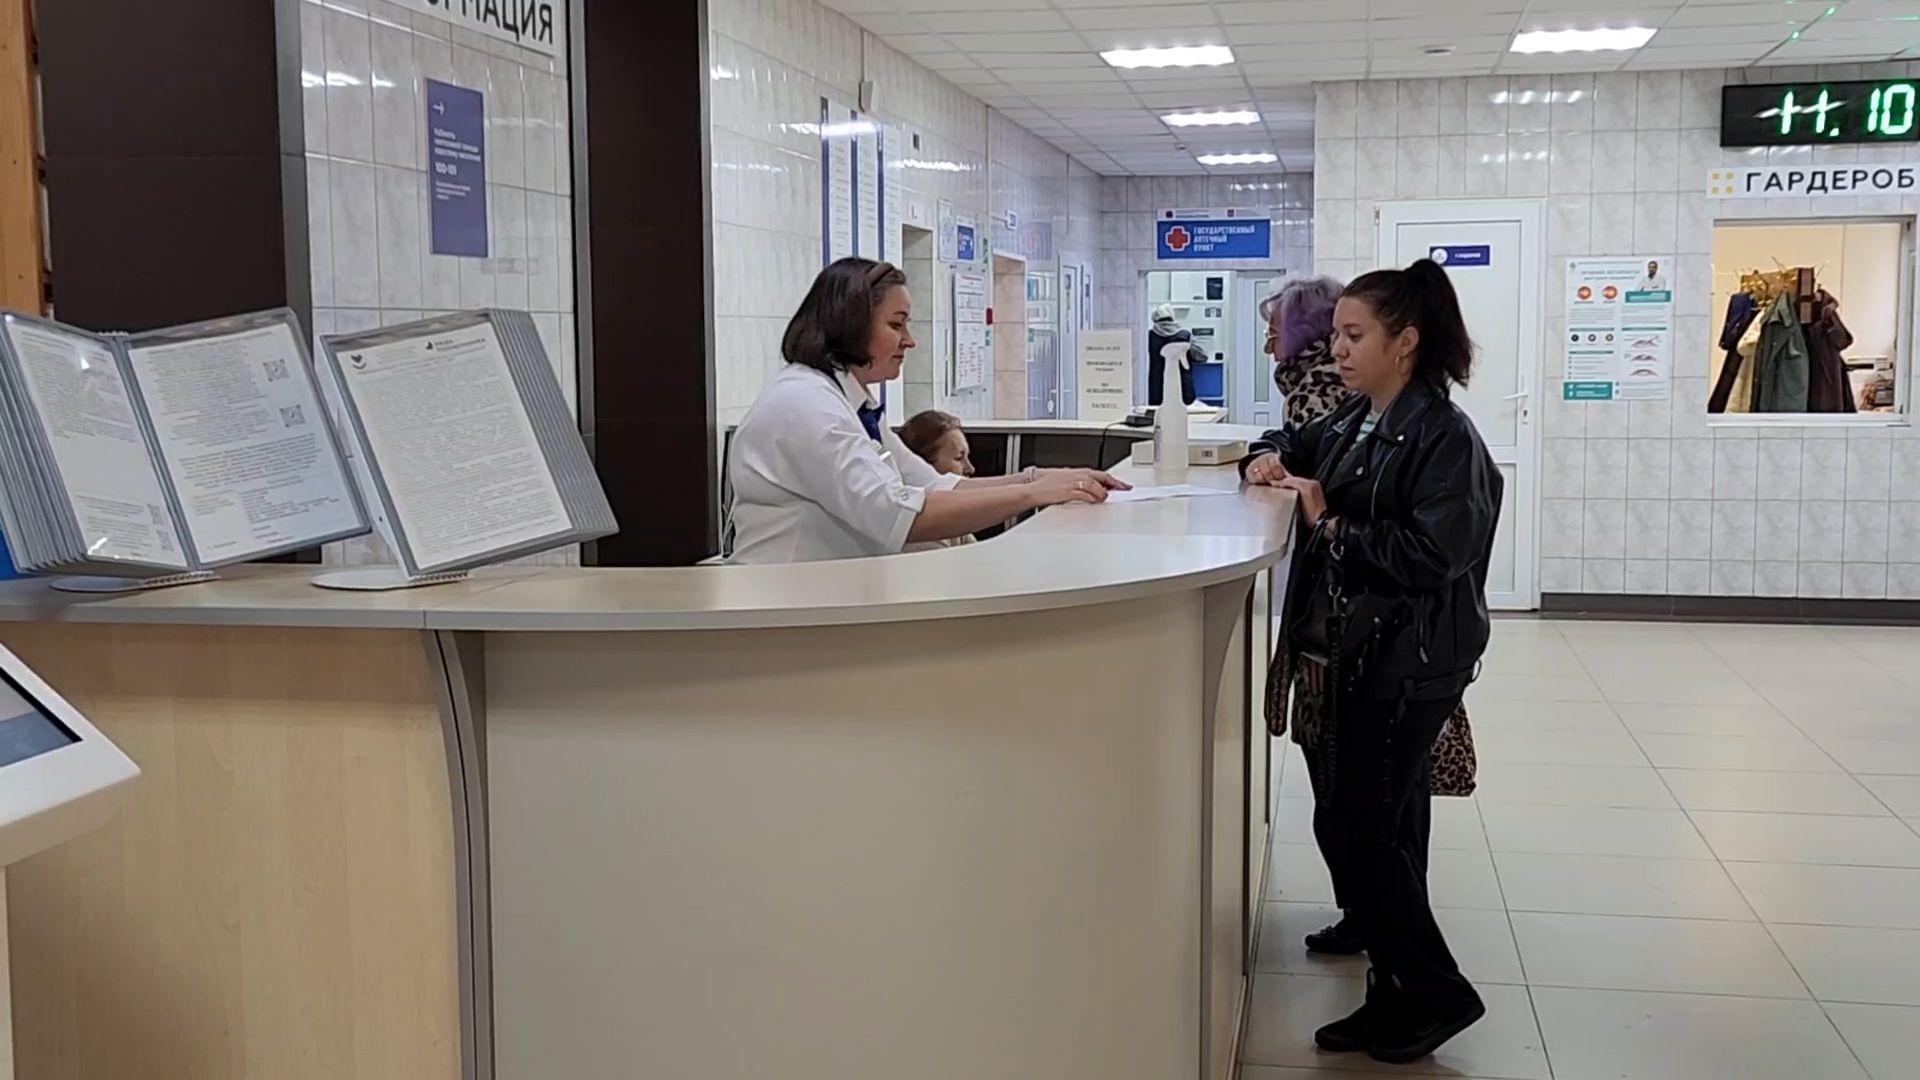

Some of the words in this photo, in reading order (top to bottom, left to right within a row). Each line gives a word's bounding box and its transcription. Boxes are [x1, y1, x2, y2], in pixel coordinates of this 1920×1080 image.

[427, 0, 553, 45] АЦИЯ
[1745, 168, 1916, 195] ГАРДЕРОБ
[1193, 224, 1256, 235] ГОСУДАРСТВЕННЫЙ
